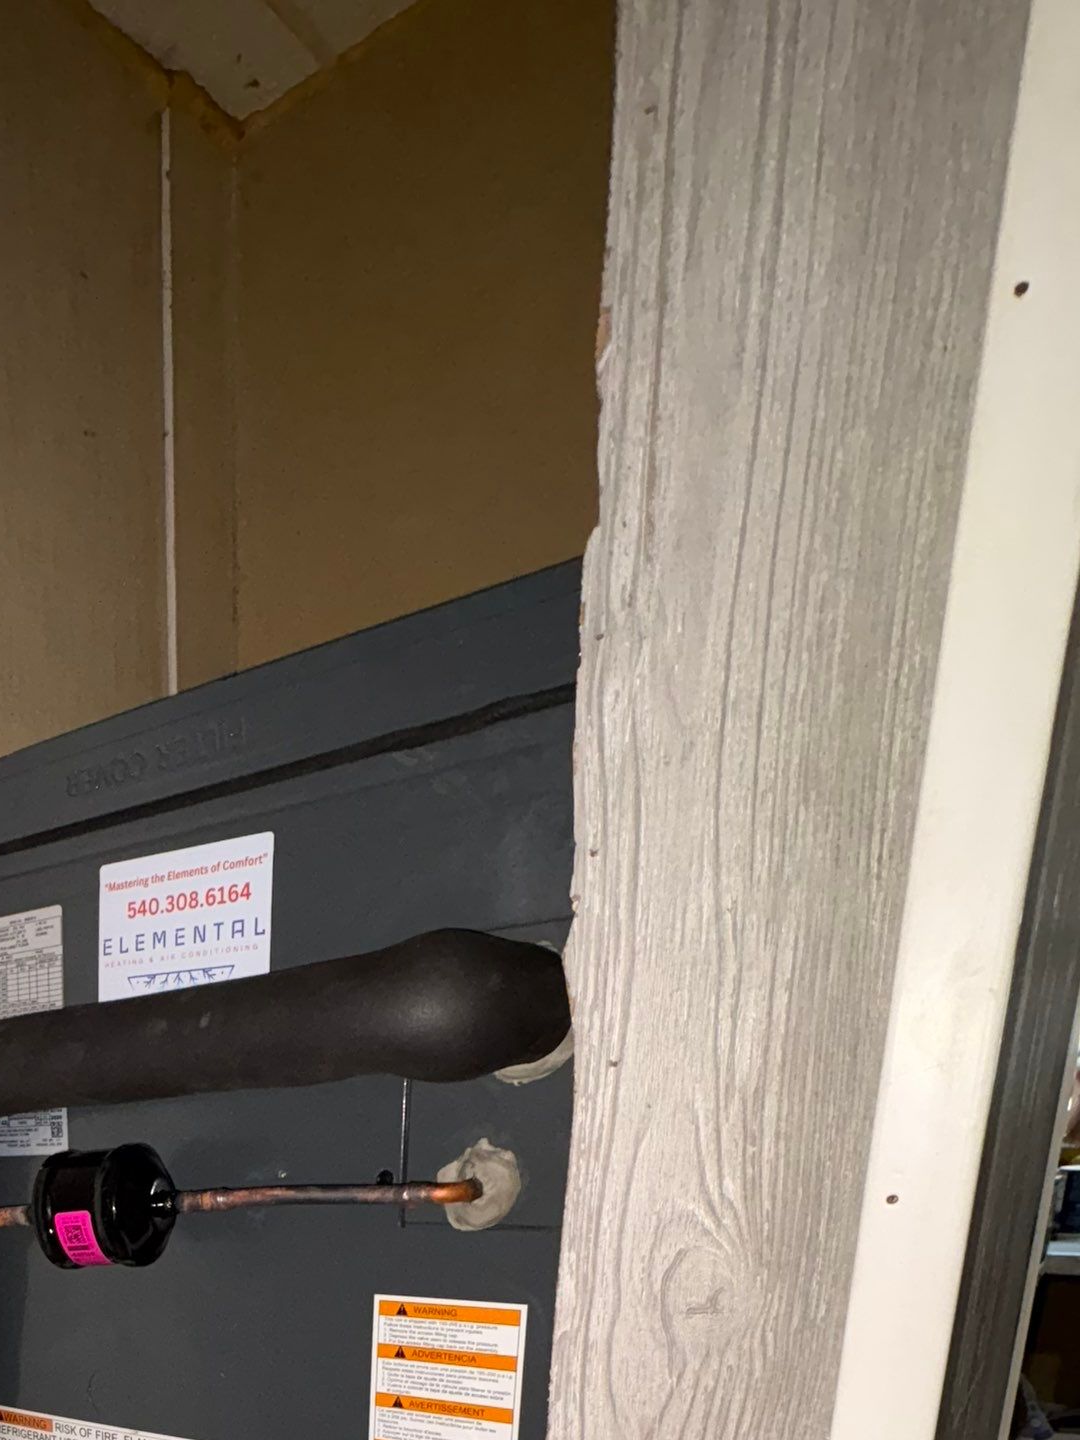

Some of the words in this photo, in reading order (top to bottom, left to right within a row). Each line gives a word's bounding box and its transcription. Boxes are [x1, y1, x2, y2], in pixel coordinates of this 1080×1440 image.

[64, 751, 147, 798] COVER
[104, 878, 150, 893] "Mastering
[151, 872, 166, 884] the
[167, 866, 209, 882] Elements
[210, 861, 223, 874] of
[222, 852, 269, 872] Comfort"
[127, 881, 253, 920] 540.308.6164
[102, 916, 267, 957] ELEMENTAL
[104, 957, 145, 969] HEATING
[160, 952, 177, 962] AIR
[180, 943, 260, 960] CONDITIONING
[412, 1305, 458, 1318] WARNING
[411, 1348, 478, 1364] ADVERTENCIA
[408, 1399, 486, 1418] AVERTISSEMENT
[3, 1411, 47, 1430] WARNING
[53, 1421, 77, 1436] RISK
[77, 1425, 93, 1439] OF
